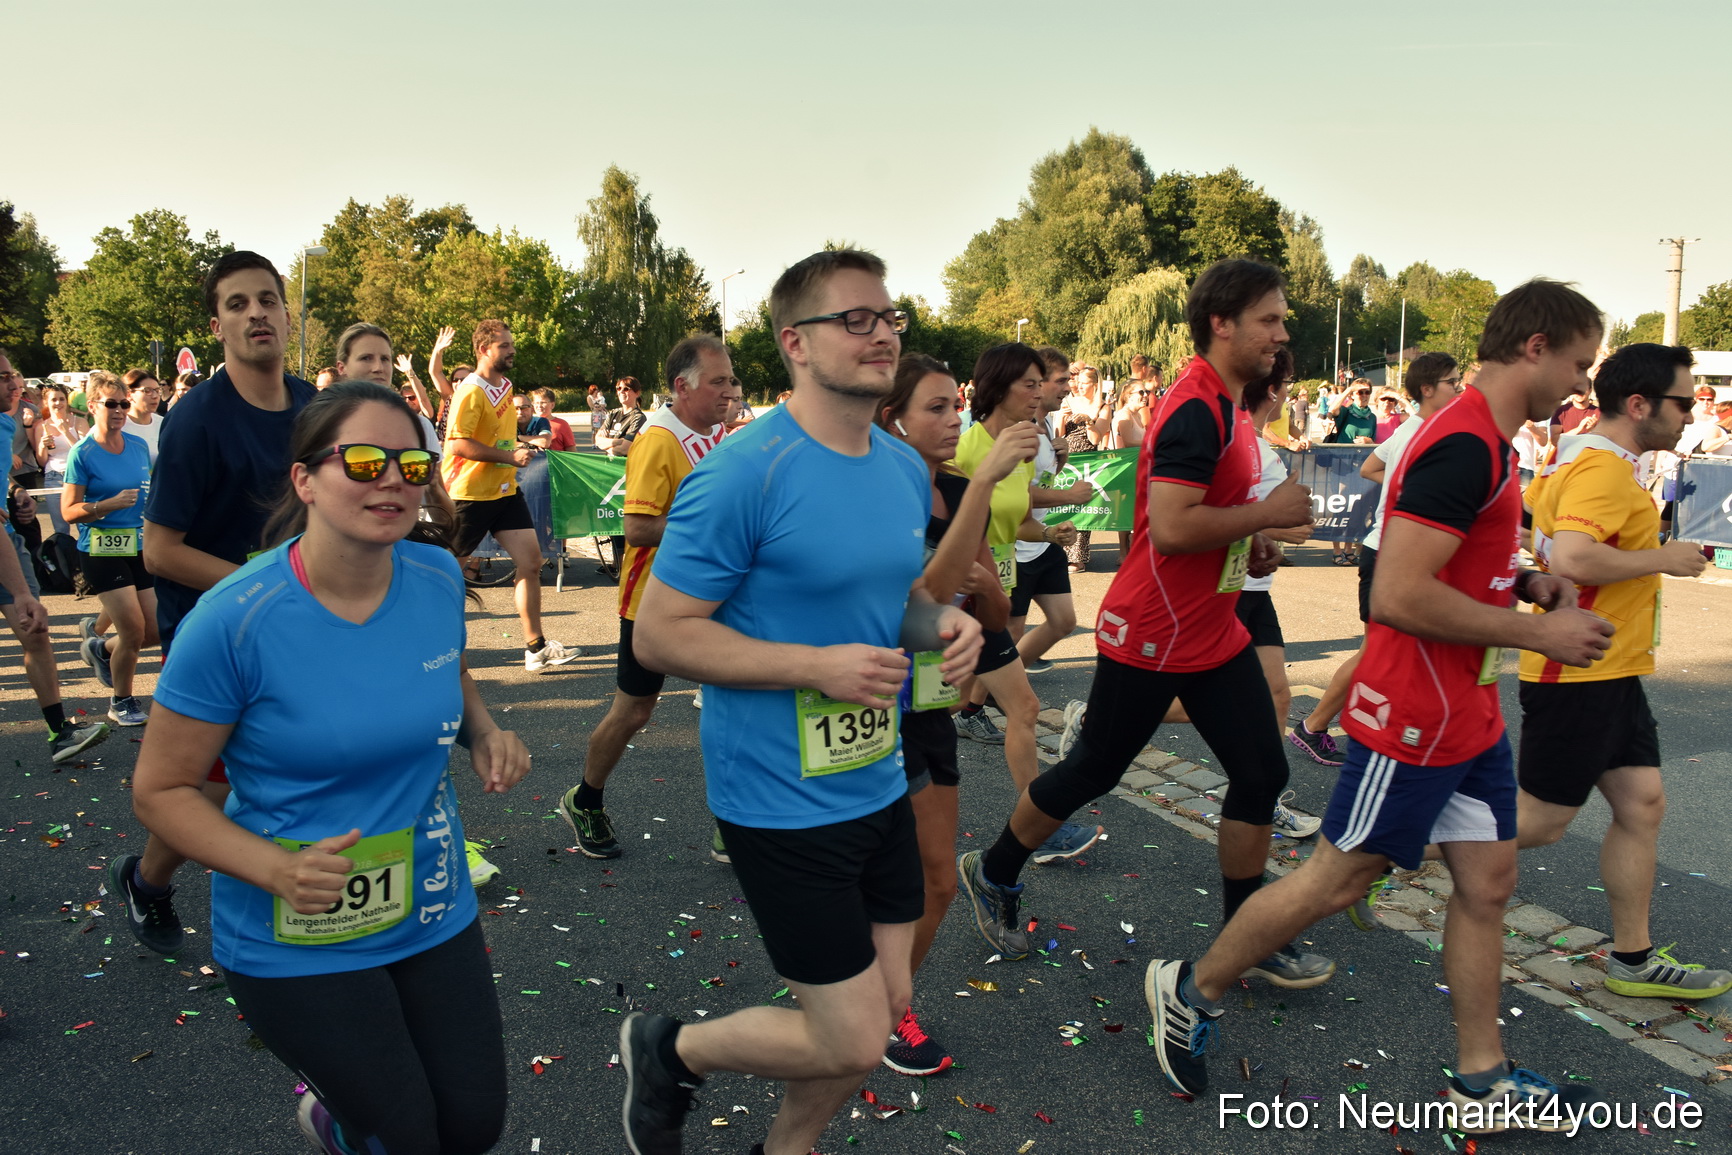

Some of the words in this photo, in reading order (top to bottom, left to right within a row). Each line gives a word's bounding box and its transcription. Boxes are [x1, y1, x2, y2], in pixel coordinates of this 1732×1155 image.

[597, 508, 615, 518] Die
[1314, 517, 1350, 527] BILE
[97, 535, 131, 547] 1397
[422, 648, 460, 673] Nathalie
[816, 708, 890, 748] 1394
[830, 747, 853, 757] Maier
[353, 860, 373, 870] 018
[286, 914, 359, 928] Lengenfelder
[361, 902, 401, 919] Nathalie
[305, 927, 336, 935] Nathalie
[338, 916, 383, 932] Lengenfelder
